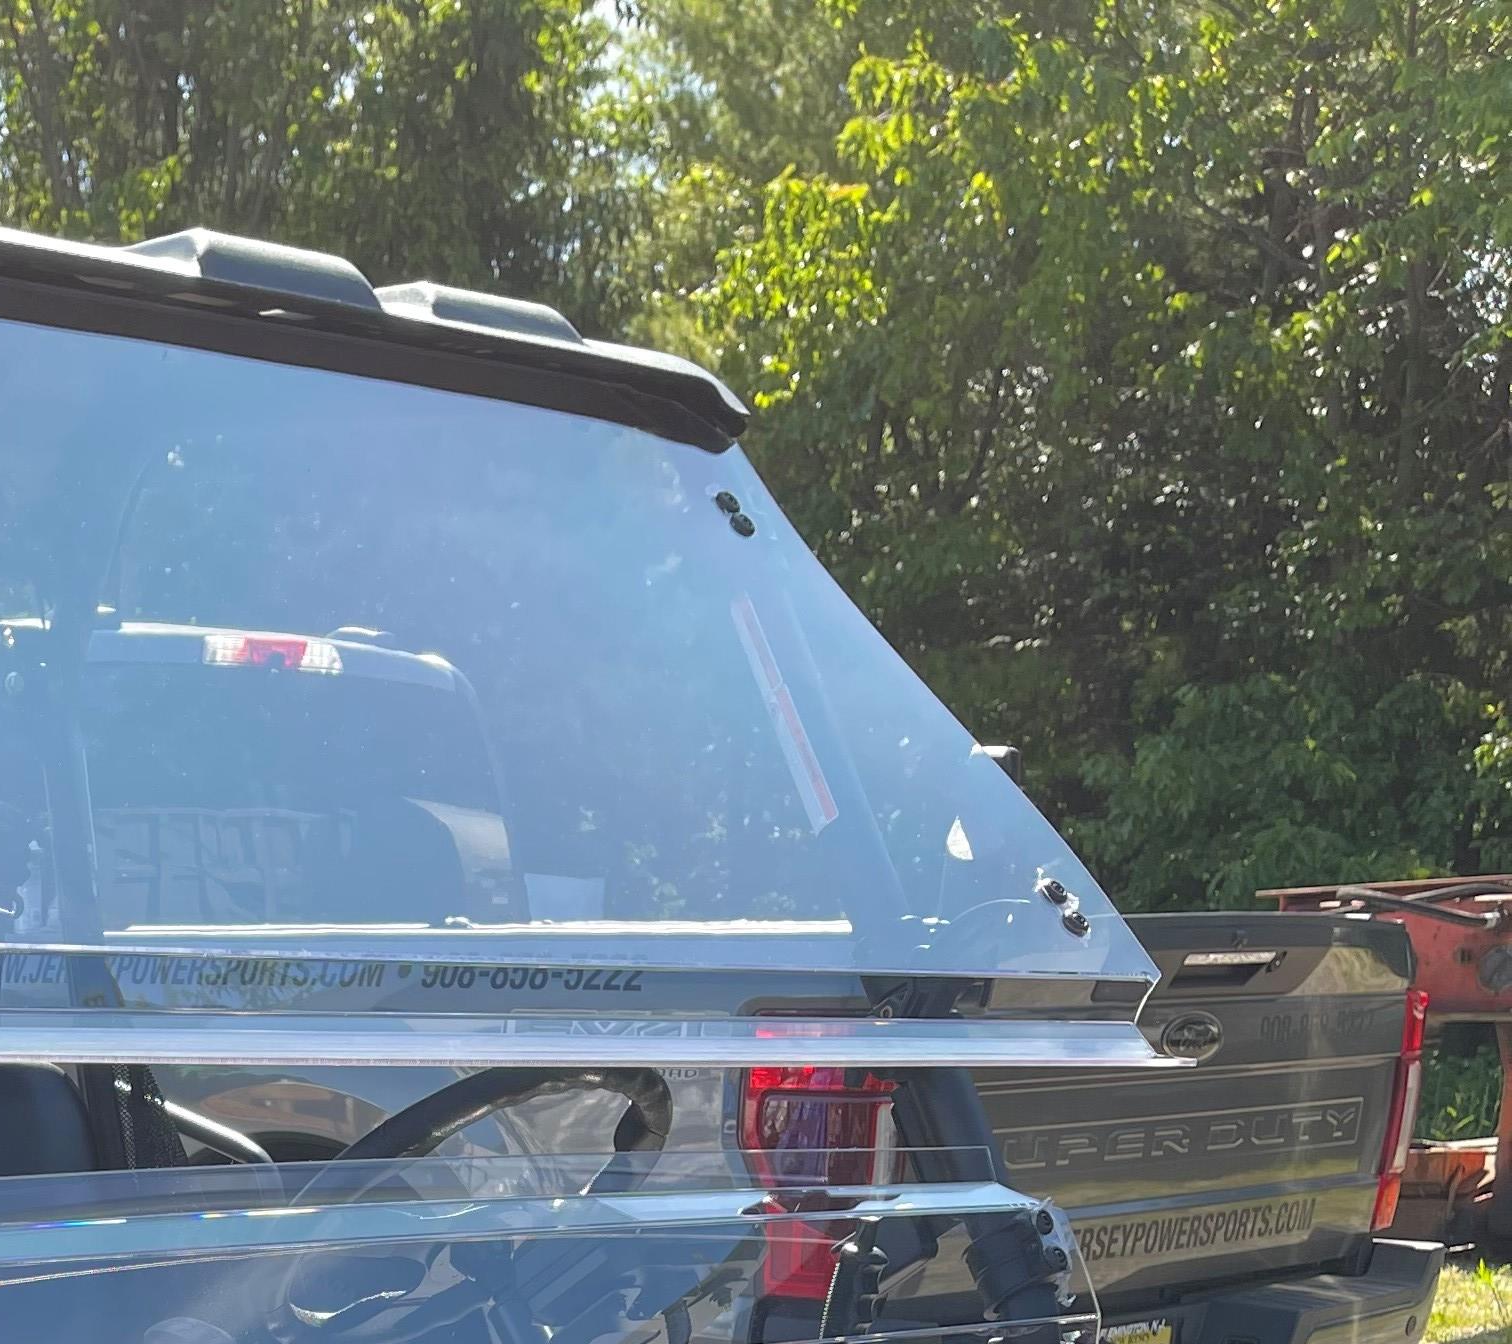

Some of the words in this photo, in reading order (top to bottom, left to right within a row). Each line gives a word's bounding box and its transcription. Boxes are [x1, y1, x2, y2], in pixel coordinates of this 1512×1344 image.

[1001, 1124, 1191, 1170] UPER
[1206, 1107, 1356, 1151] DUTY
[1074, 1198, 1315, 1262] RSEYPOWERSPORTS.COM
